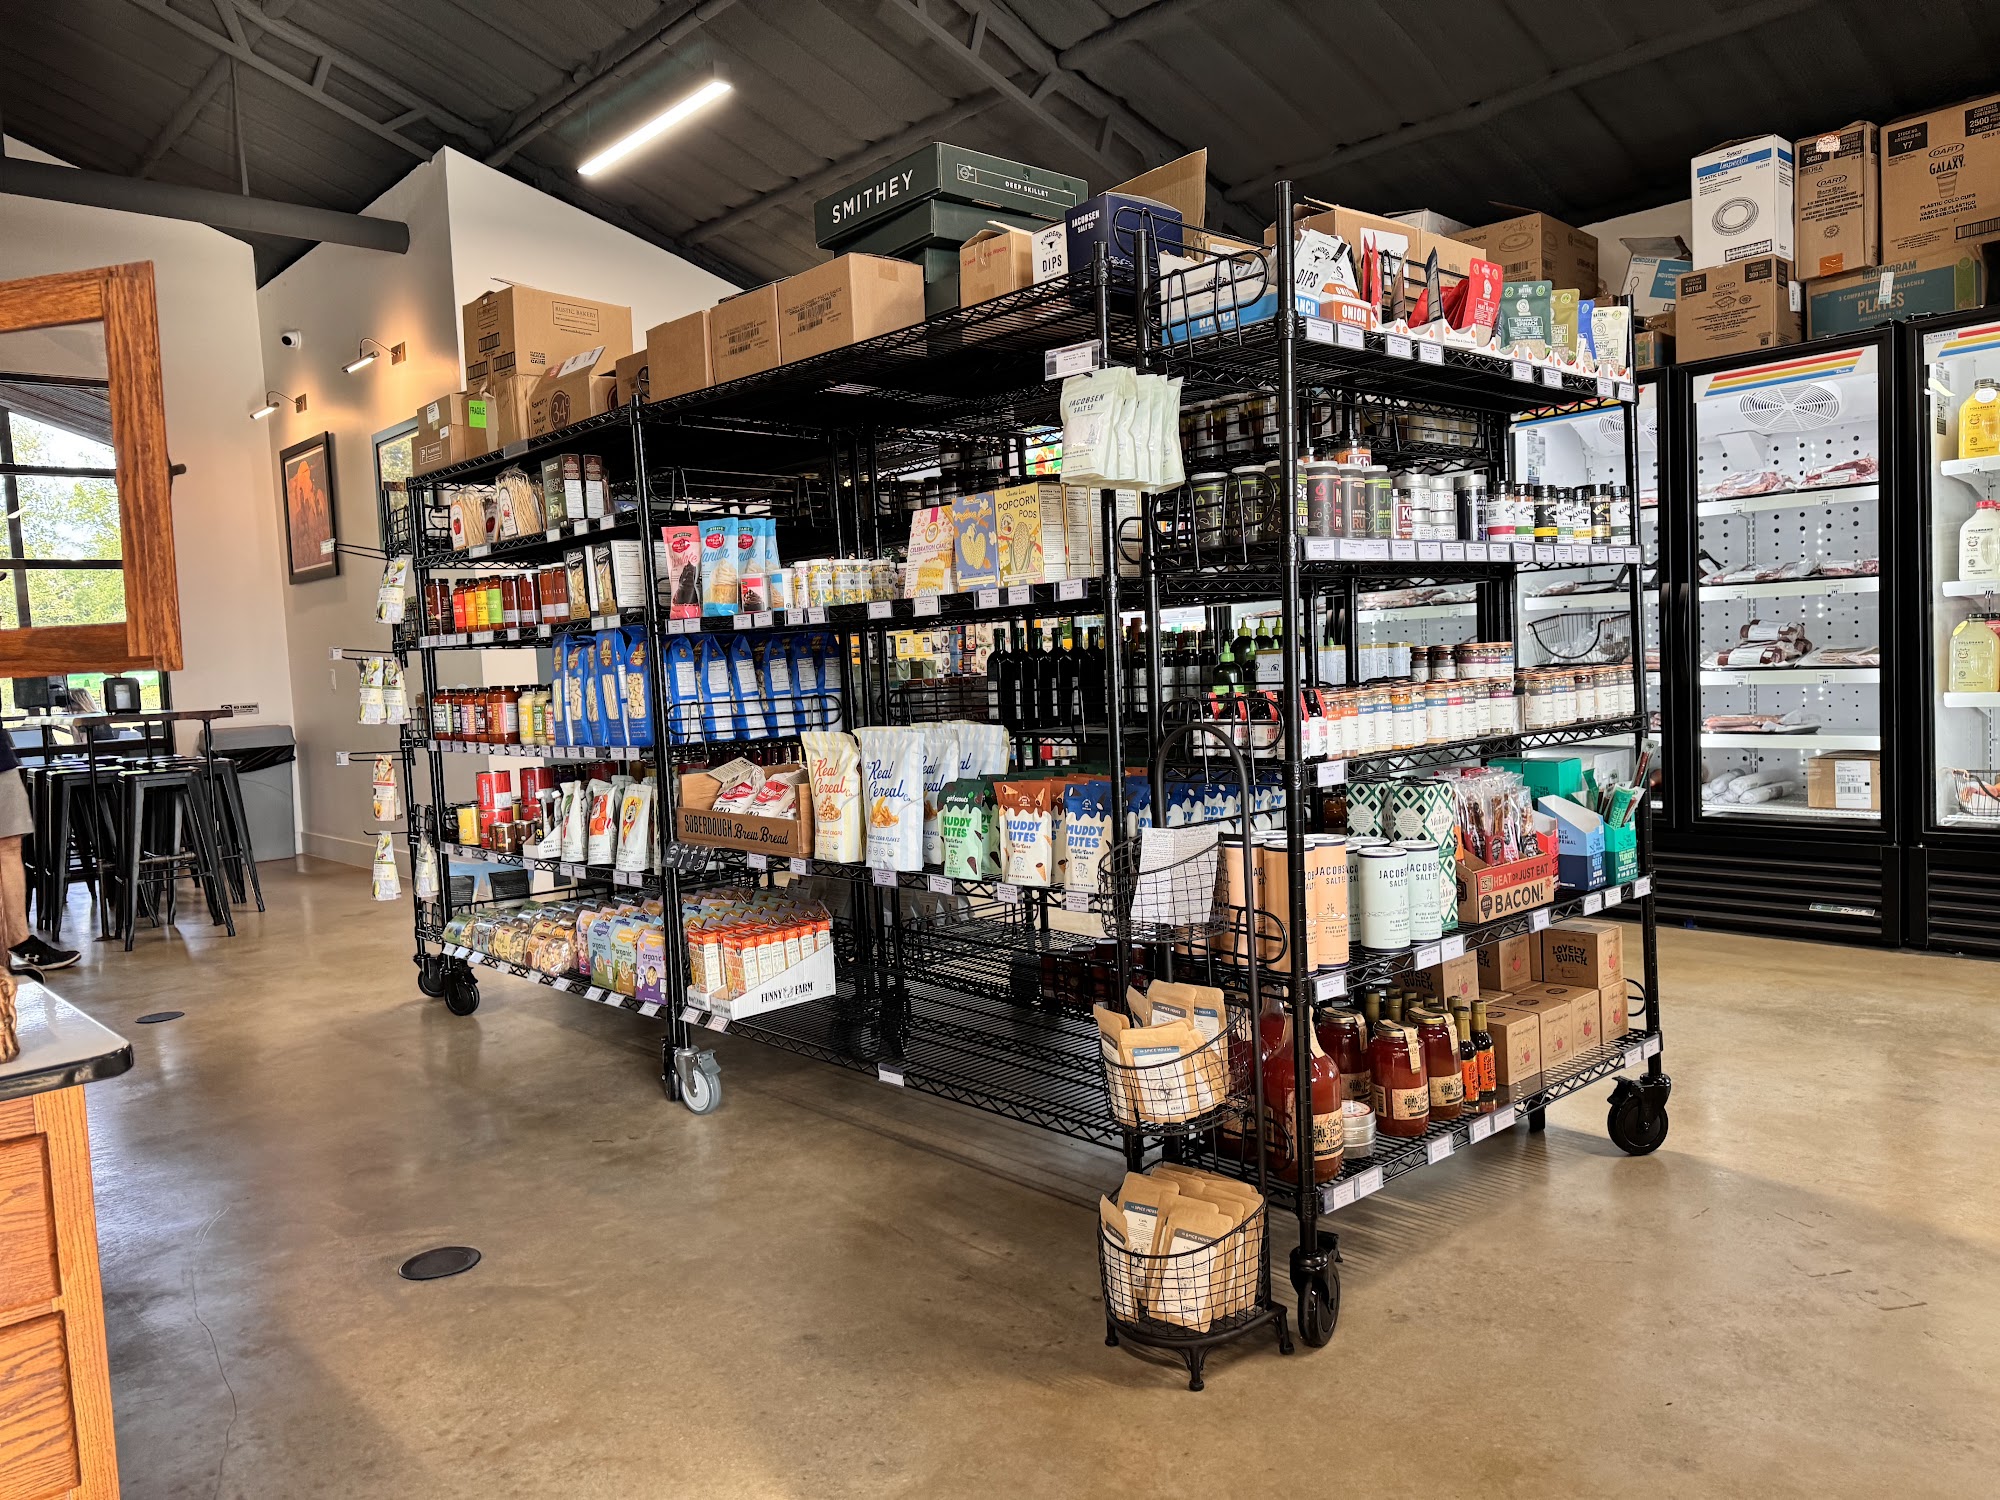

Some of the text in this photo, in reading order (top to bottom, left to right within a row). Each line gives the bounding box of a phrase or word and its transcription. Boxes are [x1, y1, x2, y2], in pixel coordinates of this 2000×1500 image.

[1970, 116, 1989, 128] 2500
[1903, 141, 1913, 150] Y7
[1933, 145, 1960, 156] DART
[1719, 156, 1749, 170] Imperial
[1930, 156, 1964, 175] GALAXY
[1005, 181, 1049, 197] DEEP SKILLET
[832, 169, 913, 224] SMITHEY
[1920, 193, 1976, 210] PLASTIC COLD CUPS
[1071, 210, 1100, 228] JACOBSEN
[1919, 214, 1935, 222] PARA
[1042, 254, 1062, 273] DIPS
[1863, 260, 1917, 280] MONOGRAM
[1296, 268, 1319, 289] DIPS
[1843, 289, 1880, 301] COMPARTMEN
[1893, 279, 1925, 293] NBLEACHED
[1294, 297, 1316, 316] ANCH
[1857, 292, 1905, 315] PLATES
[555, 306, 597, 319] RUSTIC BAKERY
[1341, 305, 1367, 323] ONION
[1068, 393, 1105, 408] JACOBSEN
[469, 406, 486, 416] FRAGILE
[1073, 406, 1087, 414] SALT
[997, 494, 1036, 512] POPCORN
[1018, 509, 1037, 519] PODS
[1352, 518, 1366, 528] RU
[1377, 517, 1390, 529] RU
[814, 757, 839, 779] Real
[868, 759, 894, 781] Real
[815, 776, 846, 797] Cereal
[868, 779, 904, 801] Cereal
[922, 774, 945, 793] real
[1203, 805, 1227, 816] DDY
[943, 815, 972, 828] MUDDY
[1006, 819, 1042, 832] MUDDY
[684, 814, 789, 845] SOBERDOUGH Brew Bread
[943, 827, 967, 838] BITES
[1066, 823, 1105, 836] MUDDY
[1008, 832, 1036, 843] BITES
[1067, 838, 1100, 849] BITES
[1314, 865, 1346, 876] JACOBS
[1379, 867, 1408, 880] JACOBS
[1493, 862, 1549, 886] HEAT OR JUST EAT
[1325, 876, 1342, 885] SALT
[1389, 878, 1404, 888] SALT
[1495, 883, 1545, 914] BACON!
[591, 941, 607, 951] organic
[615, 947, 633, 958] organic
[1552, 944, 1586, 958] LOVELY
[642, 952, 662, 962] organic
[761, 981, 814, 1003] FUNNY FARM
